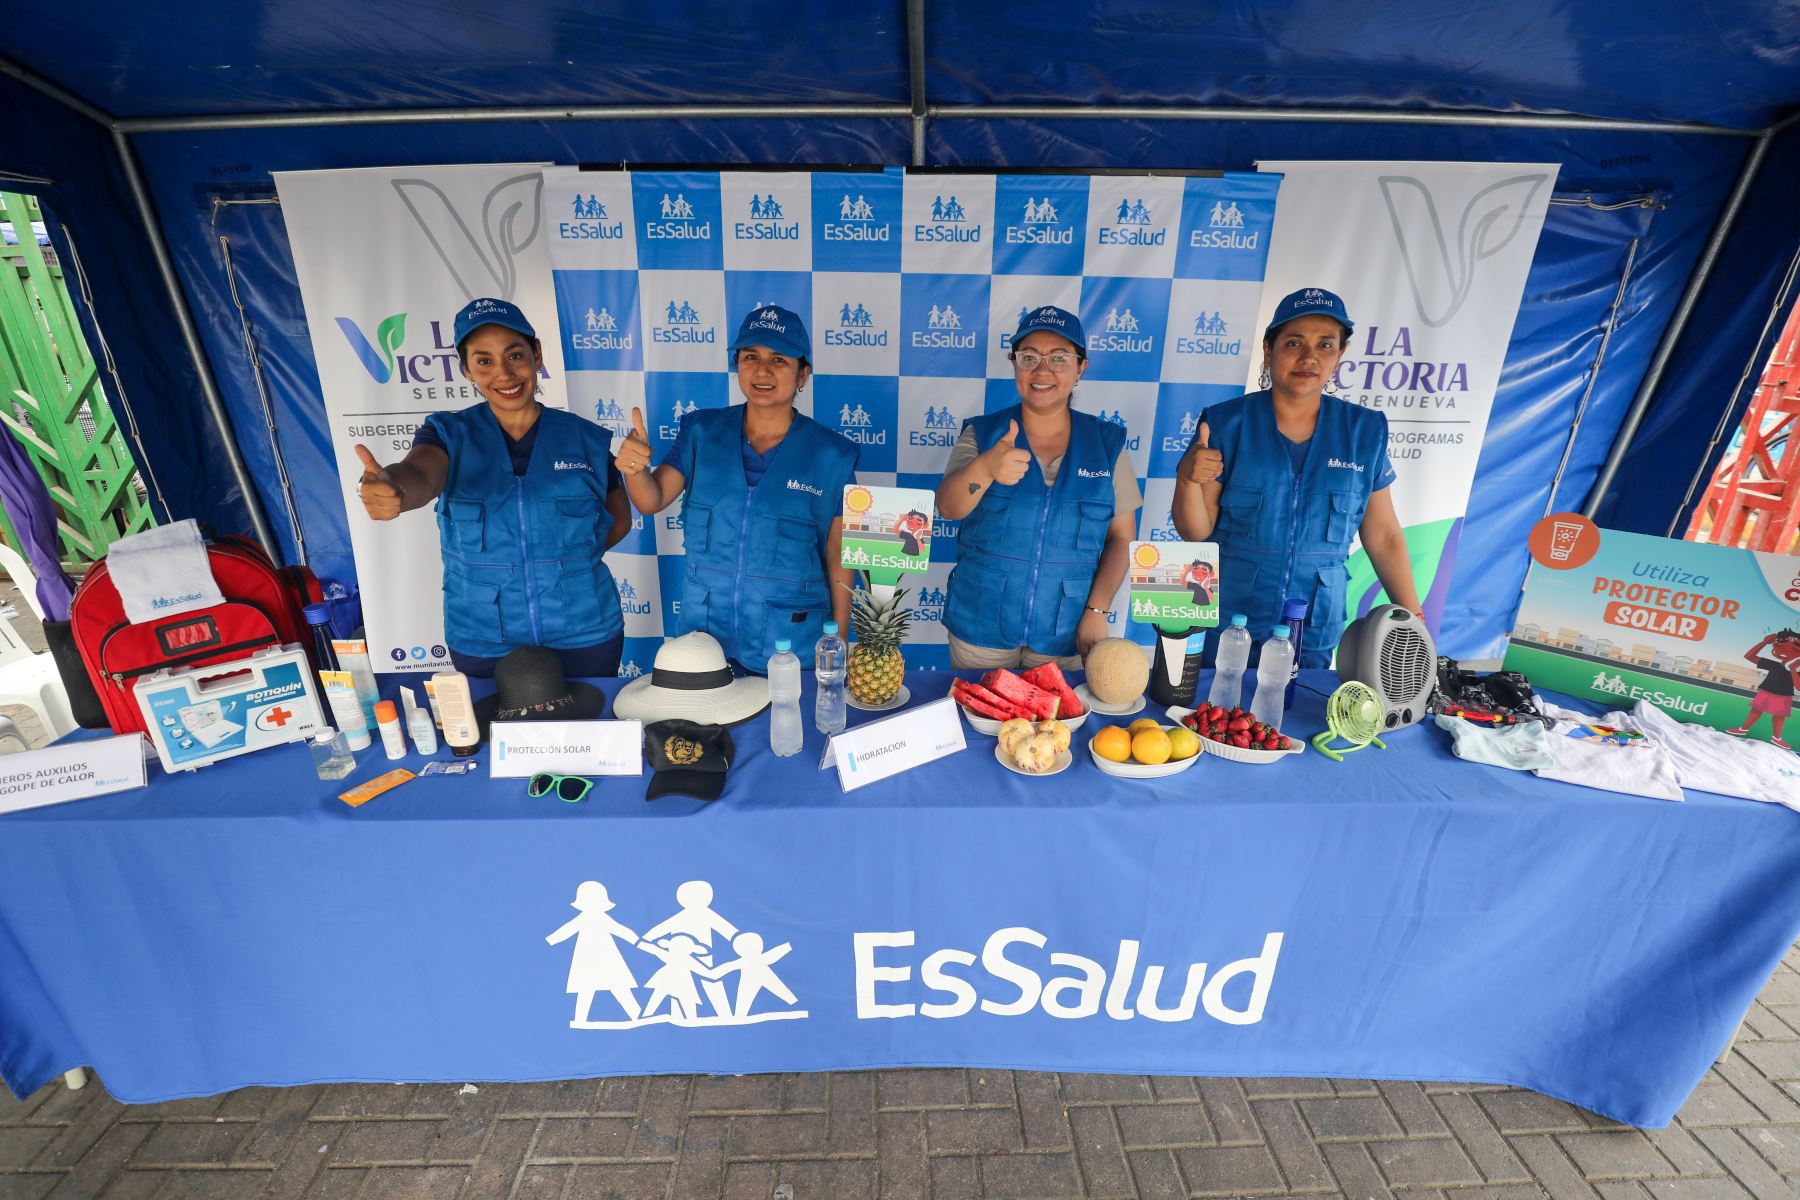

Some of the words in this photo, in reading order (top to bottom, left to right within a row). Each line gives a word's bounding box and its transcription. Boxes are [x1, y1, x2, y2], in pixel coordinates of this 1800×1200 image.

[559, 221, 623, 240] EsSalud
[646, 221, 711, 240] EsSalud
[734, 222, 799, 240] EsSalud
[823, 223, 890, 241] EsSalud
[914, 224, 981, 243] EsSalud
[1006, 225, 1073, 245] EsSalud
[1098, 227, 1166, 246] EsSalud
[1190, 230, 1257, 250] EsSalud
[1294, 298, 1333, 309] EsSalud
[430, 321, 455, 350] L
[652, 326, 715, 344] EsSalud
[749, 320, 786, 334] EsSalud
[572, 332, 633, 350] EsSalud
[823, 328, 888, 348] EsSalud
[911, 330, 976, 350] EsSalud
[1088, 334, 1153, 353] EsSalud
[1176, 337, 1241, 356] EsSalud
[1364, 326, 1413, 357] LA
[1333, 360, 1469, 393] CTORIA
[1359, 394, 1456, 408] RENUEVA
[838, 429, 886, 445] Salud
[909, 431, 960, 447] EsSalu
[1387, 433, 1464, 445] ROGRAMAS
[1386, 448, 1422, 459] ALUD
[872, 553, 929, 571] EsSalud
[1632, 561, 1710, 588] Utiliza
[622, 600, 651, 614] alud
[1592, 576, 1740, 620] PROTECTOR
[1162, 605, 1219, 620] EsSalud
[1614, 605, 1698, 638] SOLAR
[395, 660, 454, 671] www.munilavicto
[246, 682, 302, 702] BOTIQUÍN
[1629, 686, 1710, 716] EsSalud
[507, 744, 561, 755] PROTECCIÓN
[563, 745, 592, 754] SOLAR
[856, 740, 907, 764] HIDRATACIÓN
[0, 772, 33, 785] EROS
[35, 762, 88, 778] AUXILIOS
[0, 783, 37, 795] GOLPE
[40, 778, 55, 788] DE
[58, 771, 95, 785] CALOR
[853, 926, 1285, 1026] EsSalud
